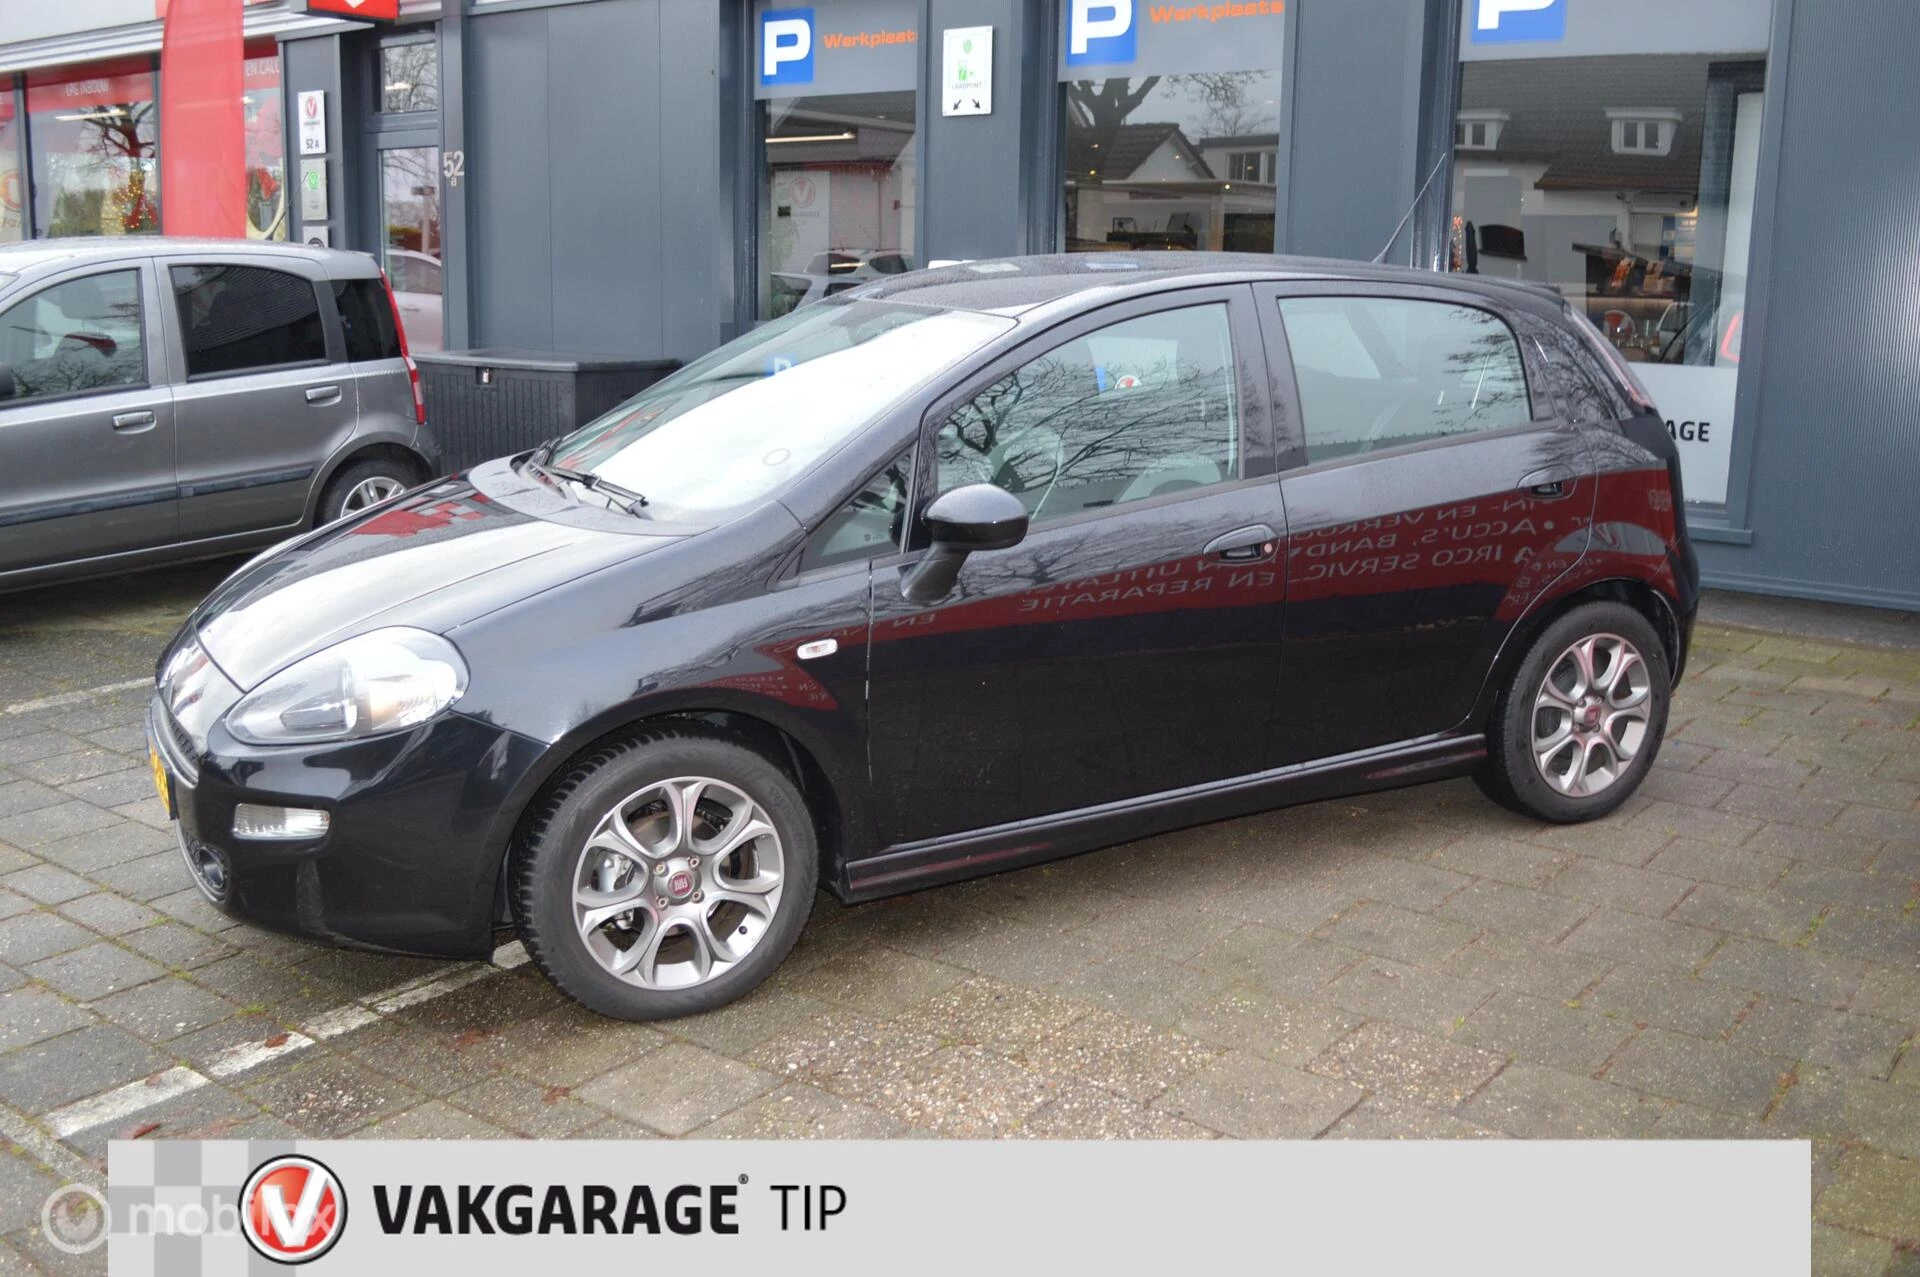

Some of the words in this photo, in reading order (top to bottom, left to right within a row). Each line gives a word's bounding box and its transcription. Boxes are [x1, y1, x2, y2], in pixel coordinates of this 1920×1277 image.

[1150, 0, 1285, 23] Werkplaats
[823, 29, 918, 49] Werkplaat
[1071, 0, 1132, 54] P
[764, 19, 811, 76] P
[443, 150, 465, 177] 52
